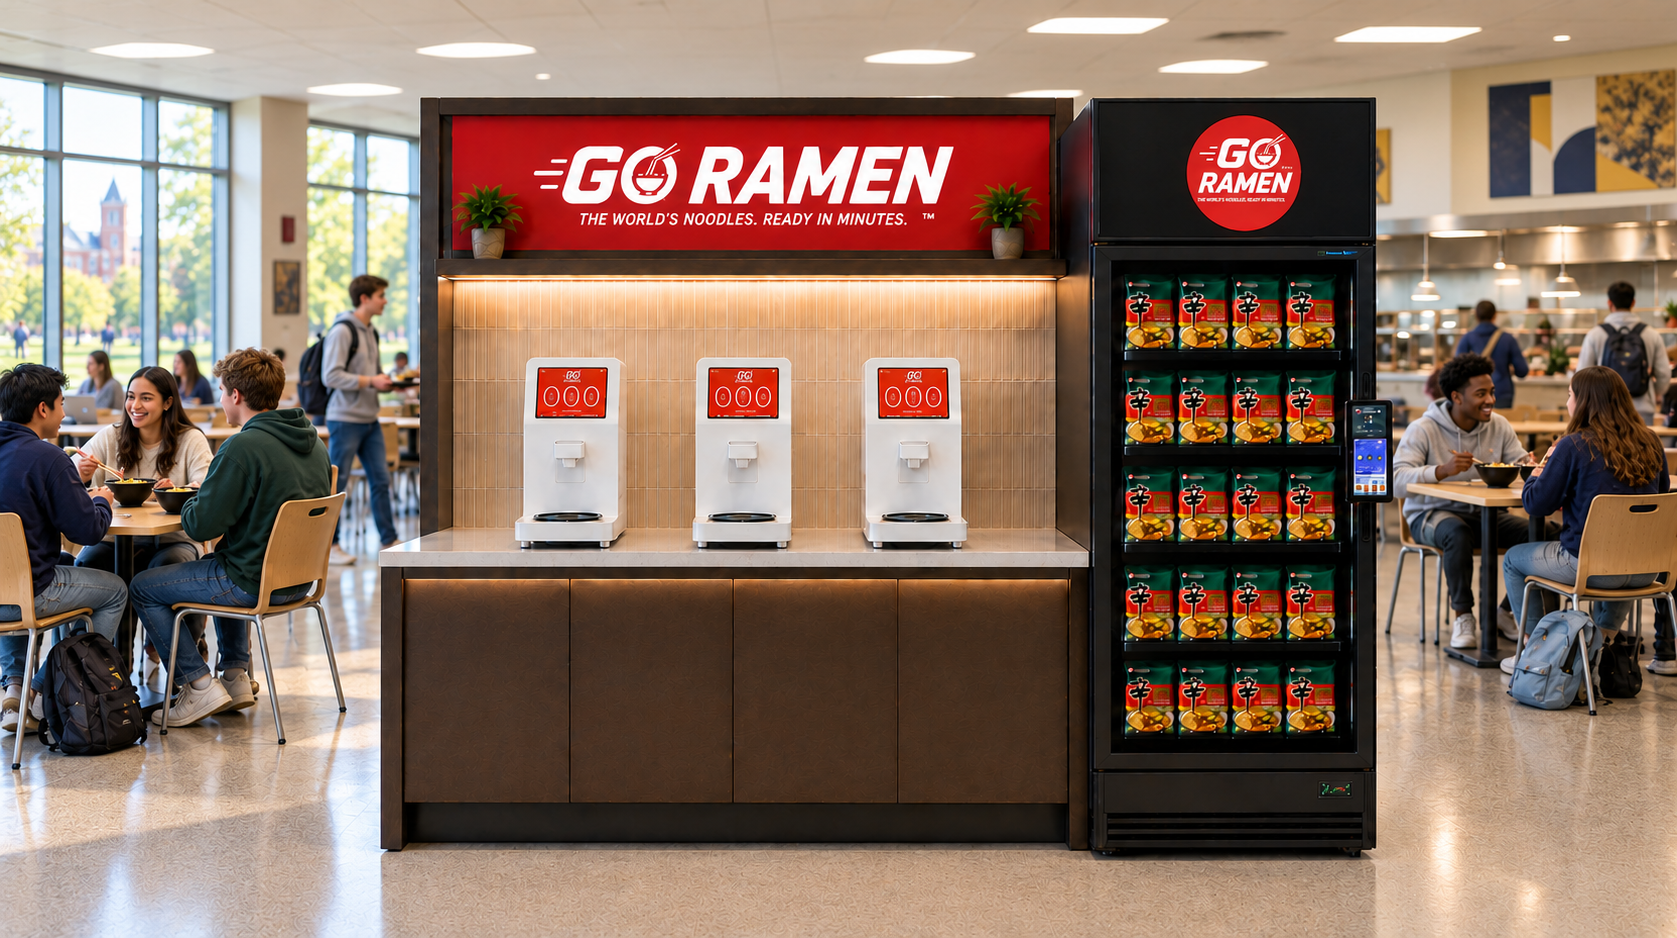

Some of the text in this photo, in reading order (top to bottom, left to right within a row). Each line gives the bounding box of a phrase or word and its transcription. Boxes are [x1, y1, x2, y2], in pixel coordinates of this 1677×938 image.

[1217, 137, 1282, 170] GO
[561, 144, 954, 205] GO RAMEN
[1198, 172, 1293, 193] RAMEN
[580, 212, 608, 225] THE
[613, 212, 679, 226] WORLD'S
[684, 212, 758, 226] NOODLES.
[763, 212, 813, 225] READY
[817, 212, 833, 225] IN
[837, 212, 908, 226] MINUTES.
